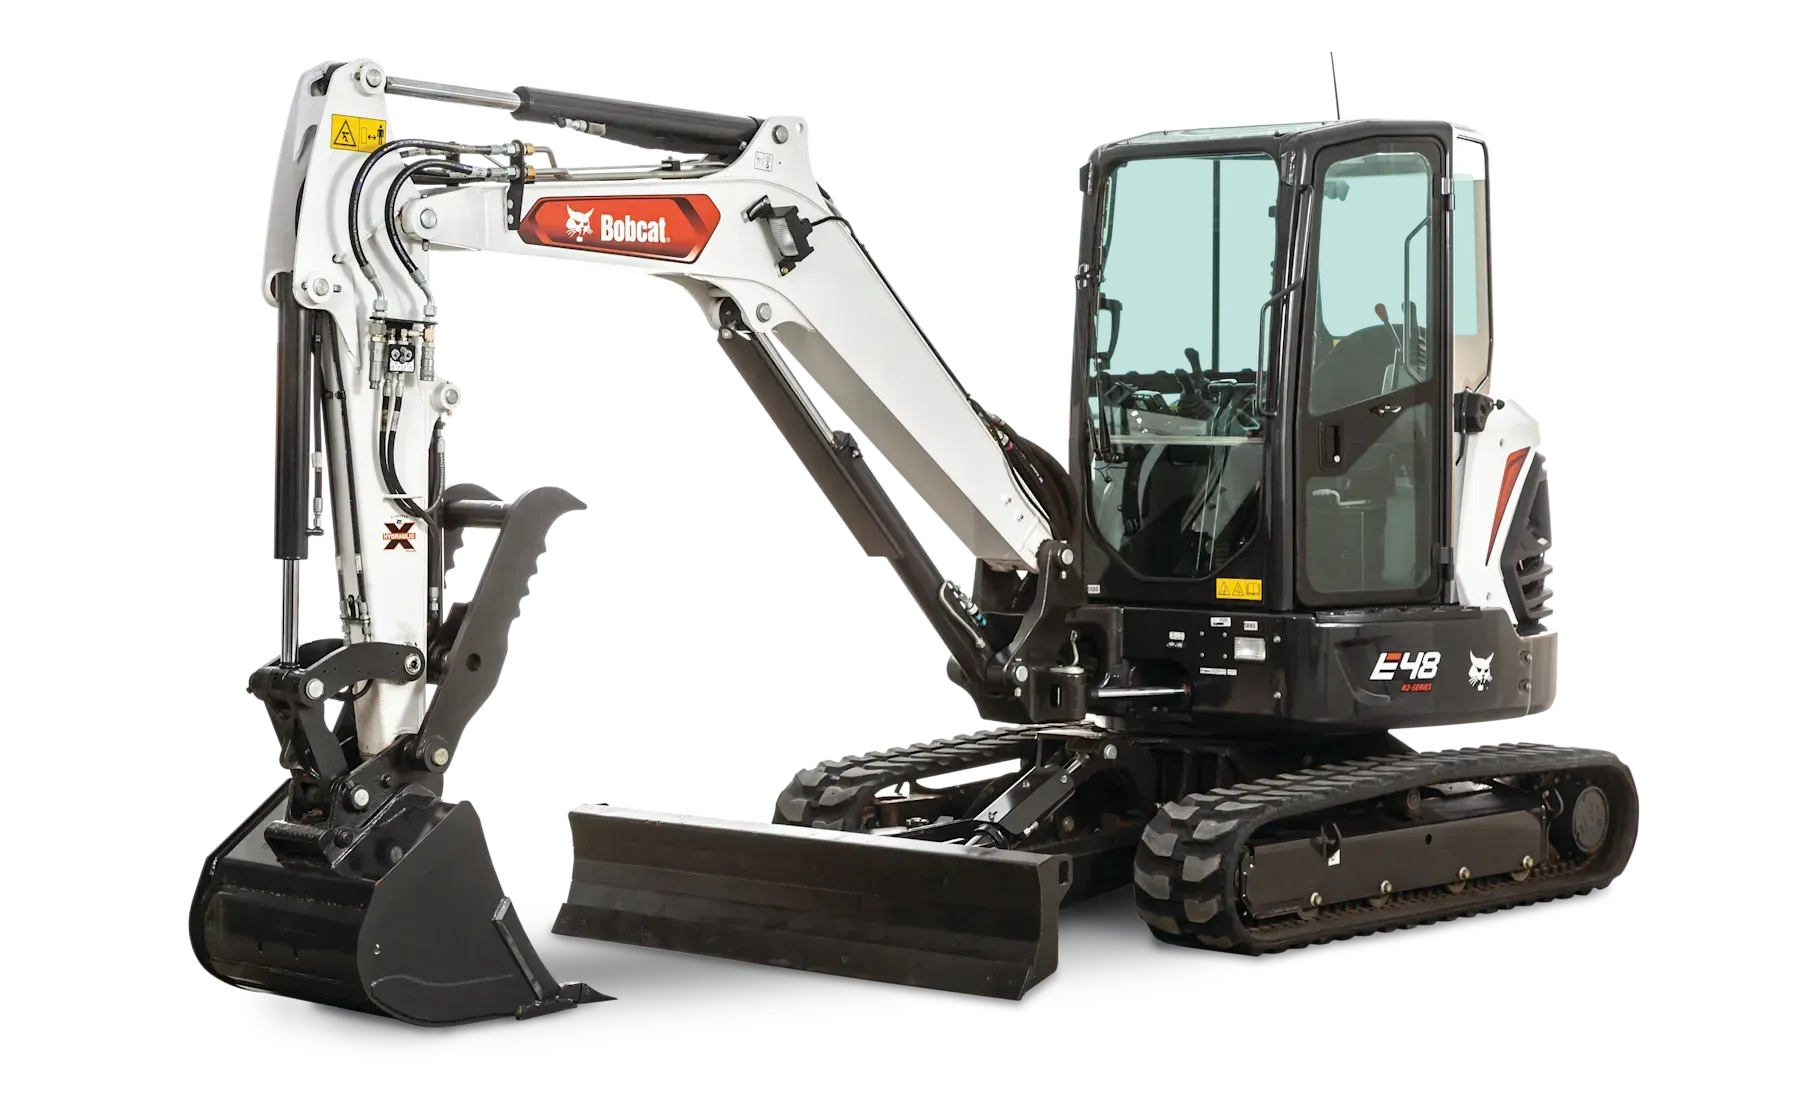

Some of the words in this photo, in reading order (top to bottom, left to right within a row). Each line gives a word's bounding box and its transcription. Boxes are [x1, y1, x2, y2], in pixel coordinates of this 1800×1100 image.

[600, 214, 667, 243] Bobcat
[1369, 651, 1441, 680] E48
[1401, 683, 1432, 692] R2-SERIES
